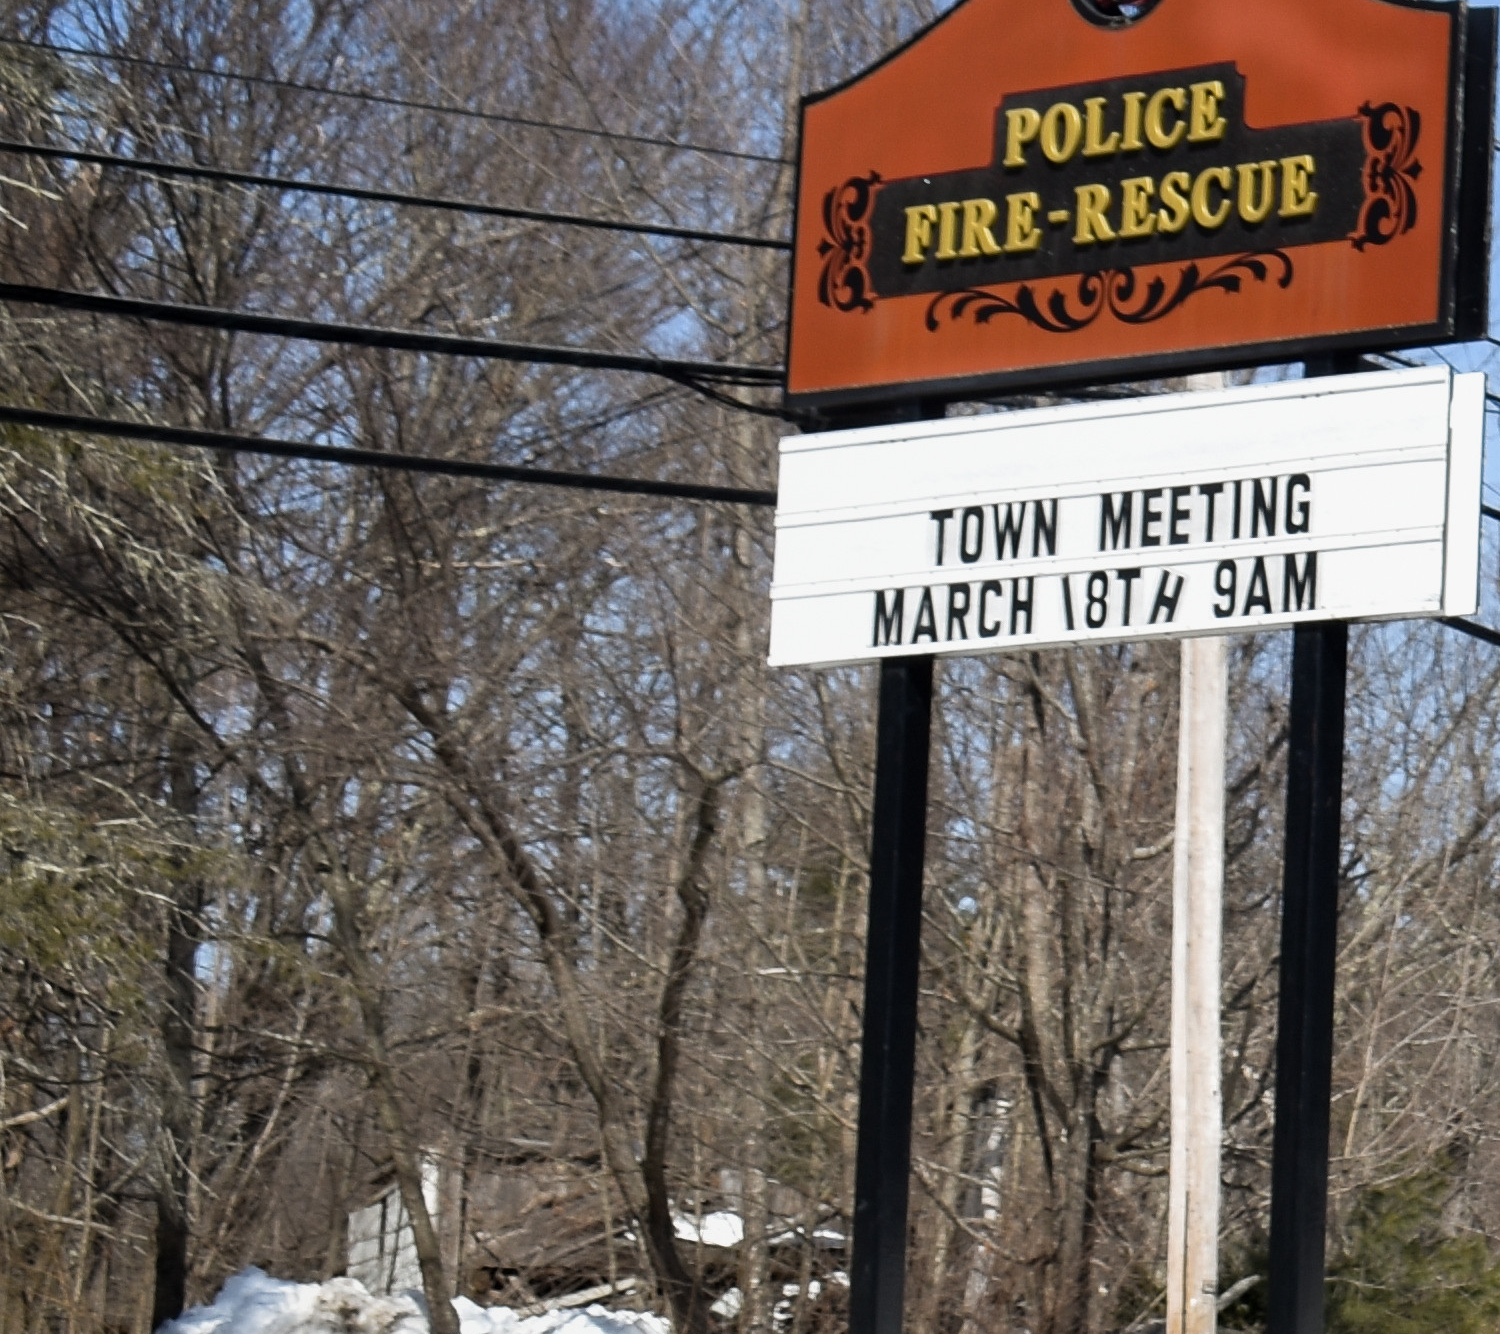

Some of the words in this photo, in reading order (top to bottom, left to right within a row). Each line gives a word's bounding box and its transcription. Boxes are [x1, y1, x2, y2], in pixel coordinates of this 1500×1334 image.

[1003, 79, 1228, 167] POLICE
[902, 155, 1318, 265] FIRE-RESCUE
[930, 497, 1058, 566] TOWN
[1099, 472, 1310, 552] MEETING
[873, 575, 1035, 647] MARCH
[1062, 566, 1186, 631] 18TH
[1213, 551, 1318, 618] 9AM
